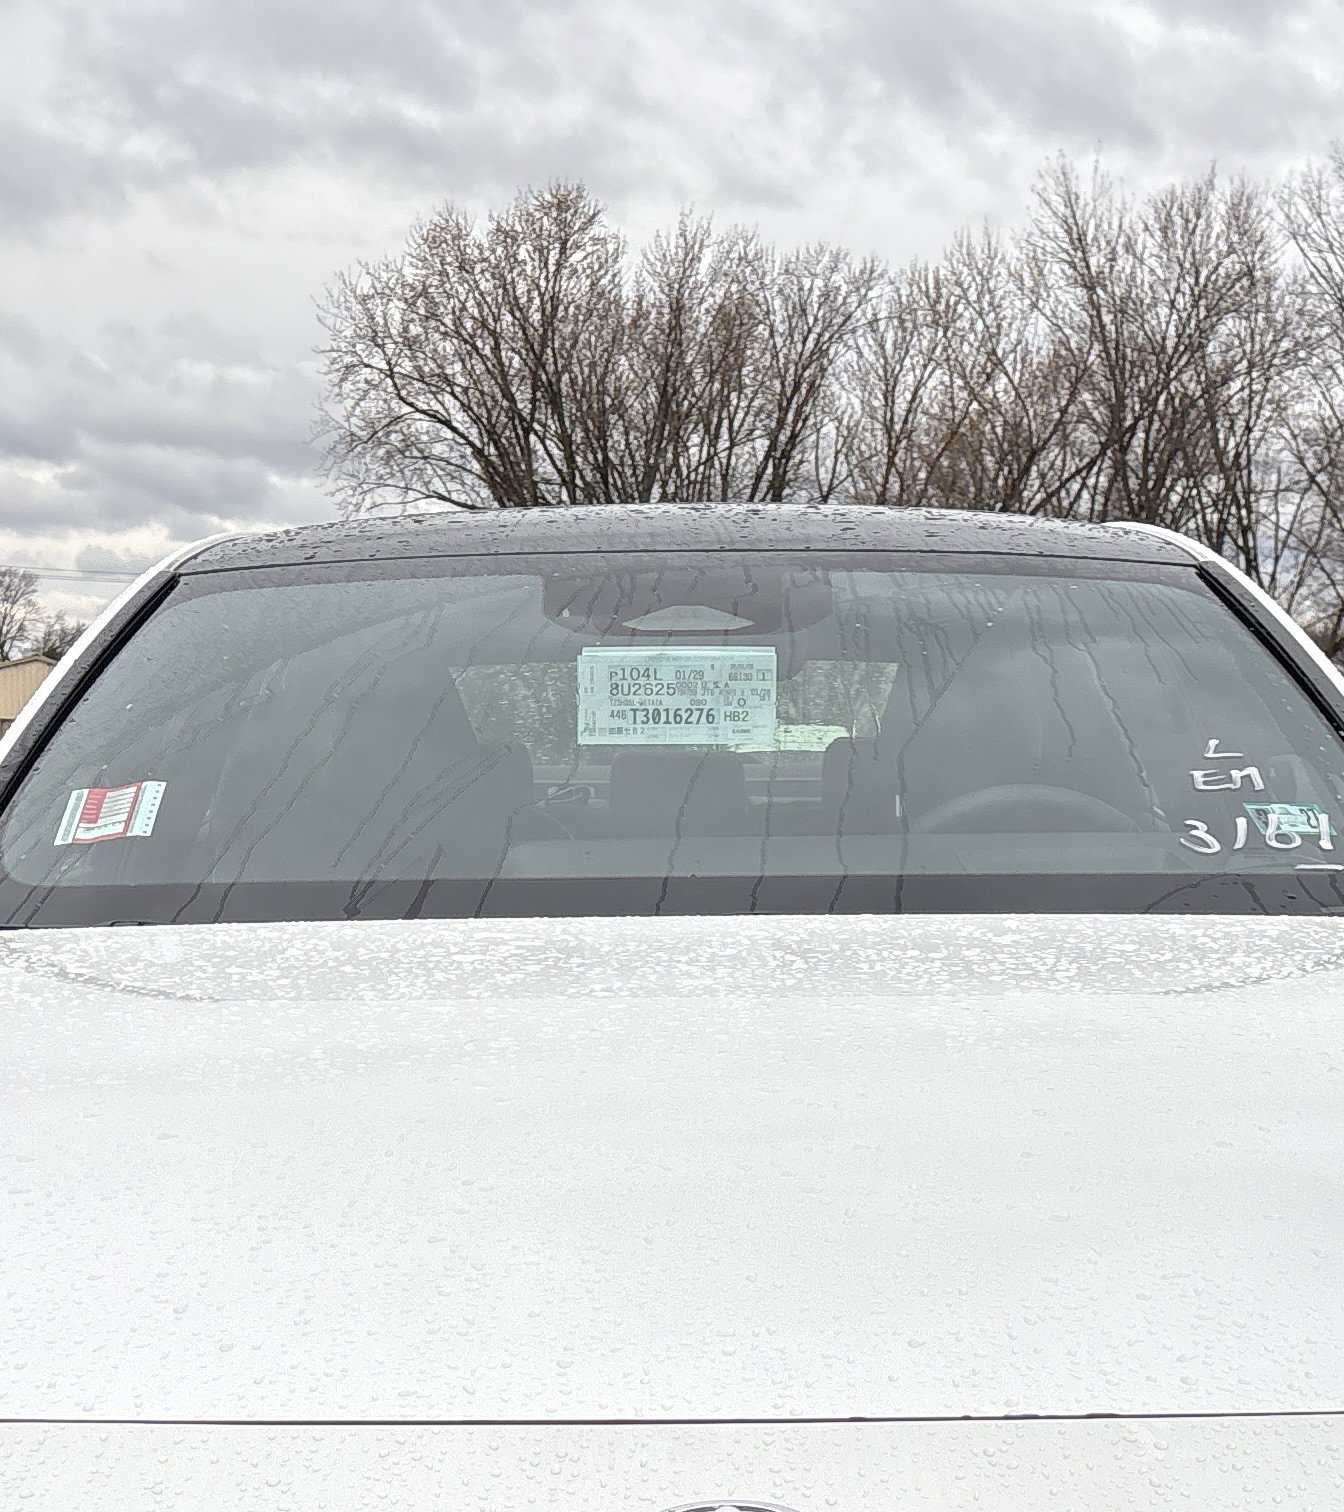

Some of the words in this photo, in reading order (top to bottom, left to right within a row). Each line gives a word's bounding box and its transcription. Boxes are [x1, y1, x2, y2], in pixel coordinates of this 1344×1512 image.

[609, 667, 663, 681] P104L
[675, 669, 704, 681] 01/29
[609, 682, 676, 696] 8U2625
[629, 707, 716, 725] T3016276
[723, 710, 749, 722] HB2
